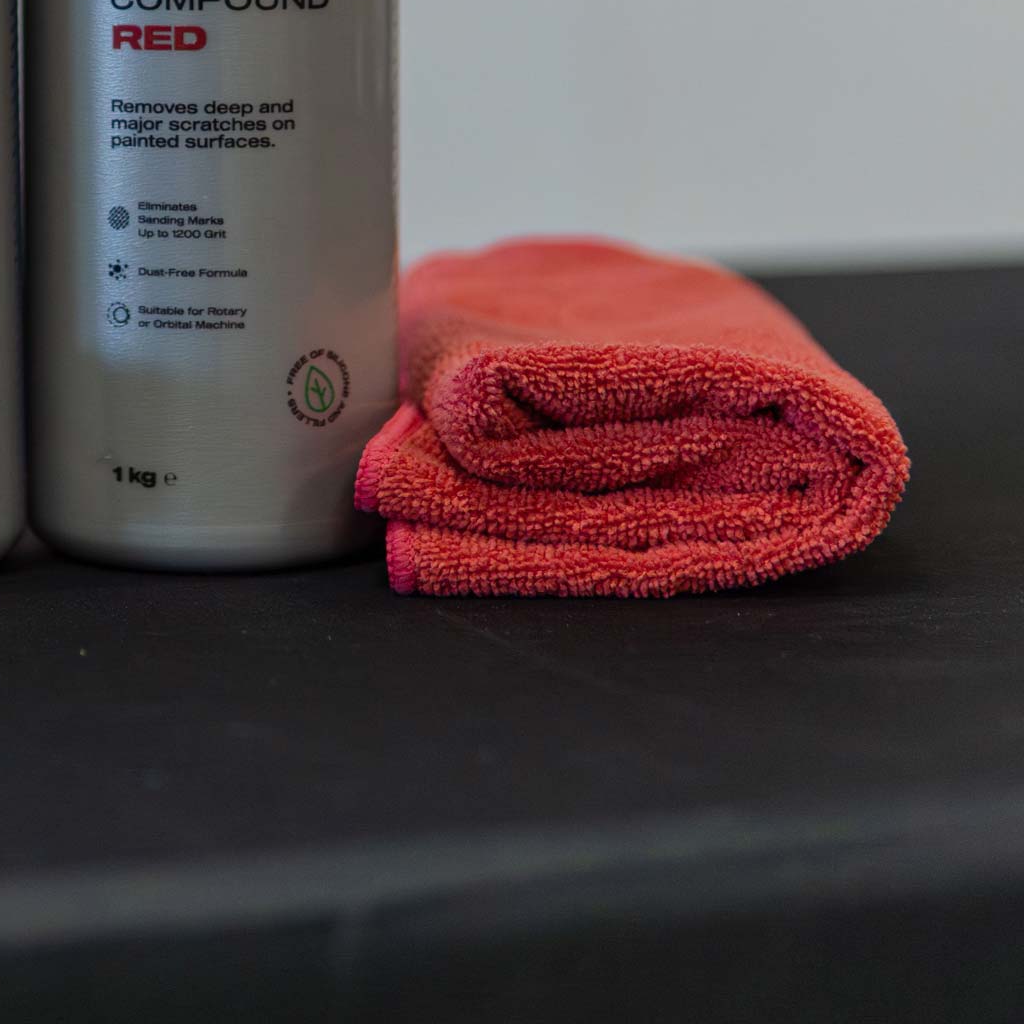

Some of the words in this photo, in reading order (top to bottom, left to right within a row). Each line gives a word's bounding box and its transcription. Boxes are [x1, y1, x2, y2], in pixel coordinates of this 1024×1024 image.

[112, 25, 207, 51] RED
[111, 99, 198, 114] Removes
[204, 100, 253, 117] deep
[259, 99, 294, 114] and
[111, 117, 163, 133] major
[169, 117, 266, 132] scratches
[272, 118, 295, 131] on
[111, 134, 180, 149] painted
[185, 134, 276, 149] surfaces.
[137, 201, 197, 211] Eliminates
[137, 215, 185, 227] Sanding
[187, 216, 224, 225] Marks
[137, 229, 154, 239] Up
[157, 229, 169, 238] to
[172, 229, 201, 239] 1200
[204, 229, 227, 239] Grit
[137, 267, 196, 277] Dust-Free
[198, 268, 248, 277] Formula
[138, 305, 185, 316] Suitable
[187, 306, 205, 315] for
[207, 307, 248, 317] Rotary
[138, 320, 151, 328] or
[153, 319, 193, 329] Orbital
[195, 320, 246, 330] Machine
